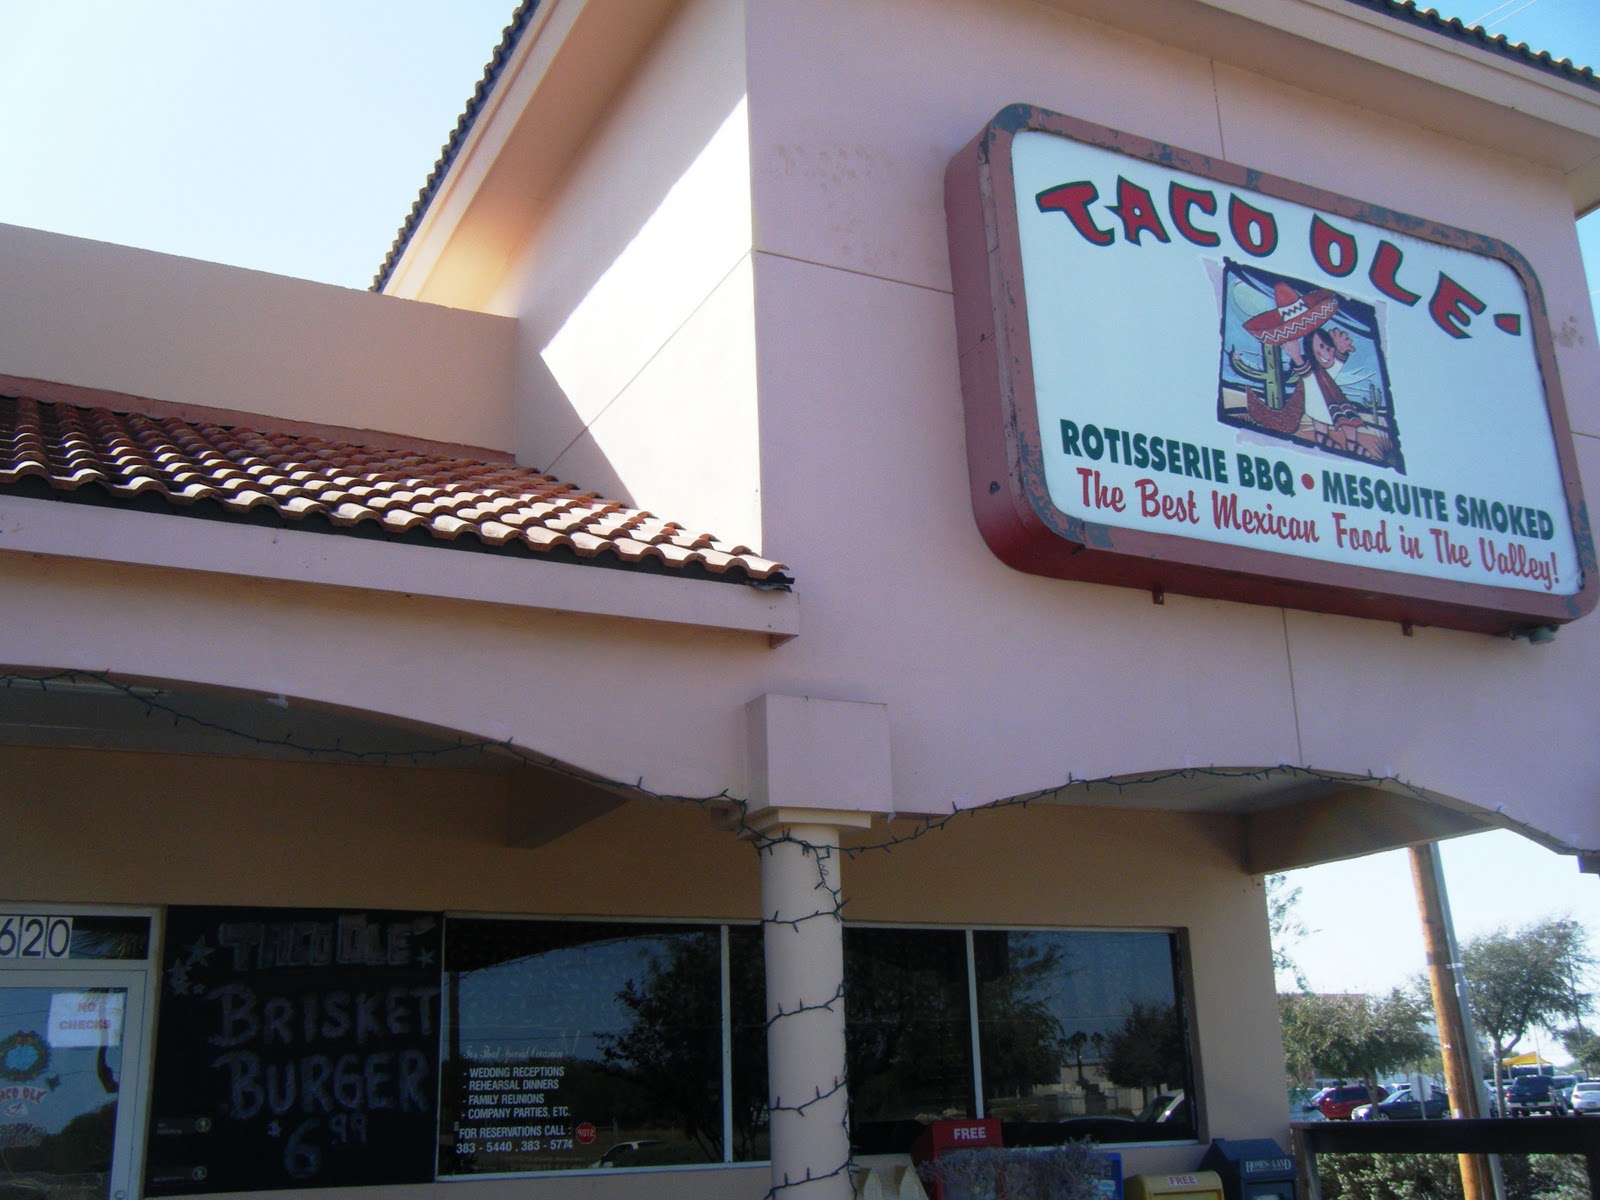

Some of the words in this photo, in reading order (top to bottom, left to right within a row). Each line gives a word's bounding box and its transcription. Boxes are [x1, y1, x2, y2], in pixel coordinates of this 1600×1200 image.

[1035, 174, 1278, 257] TACO
[1060, 419, 1229, 484] ROTISSERIE
[1236, 453, 1296, 498] BBQ
[1322, 470, 1449, 522] MESQUITE
[1455, 494, 1554, 541] SMOKED
[1076, 467, 1126, 513] The
[1134, 478, 1199, 524] Best
[1211, 490, 1319, 543] Mexican
[1332, 512, 1391, 553] Food
[1399, 525, 1423, 560] in
[1429, 528, 1471, 568] The
[1479, 537, 1560, 591] Valley!
[78, 1002, 97, 1012] NO
[206, 982, 440, 1048] BRISKET
[59, 1019, 111, 1030] CHECKS
[469, 1067, 510, 1078] WEDDING
[512, 1066, 565, 1077] RECEPTIONS
[208, 1048, 431, 1120] BURGER
[469, 1080, 520, 1091] REHEARSAL
[523, 1079, 559, 1090] DINNERS
[468, 1095, 499, 1105] FAMILY
[501, 1094, 544, 1104] REUNIONS
[468, 1108, 511, 1119] COMPANY
[552, 1106, 571, 1117] ETC.
[459, 1128, 477, 1139] FOR
[479, 1126, 542, 1139] RESERVATIONS
[953, 1127, 987, 1140] FREE
[456, 1143, 476, 1154] 383
[486, 1141, 513, 1152] 5440
[521, 1141, 540, 1151] 383
[550, 1139, 573, 1150] 5774
[1169, 1176, 1196, 1186] FREE
